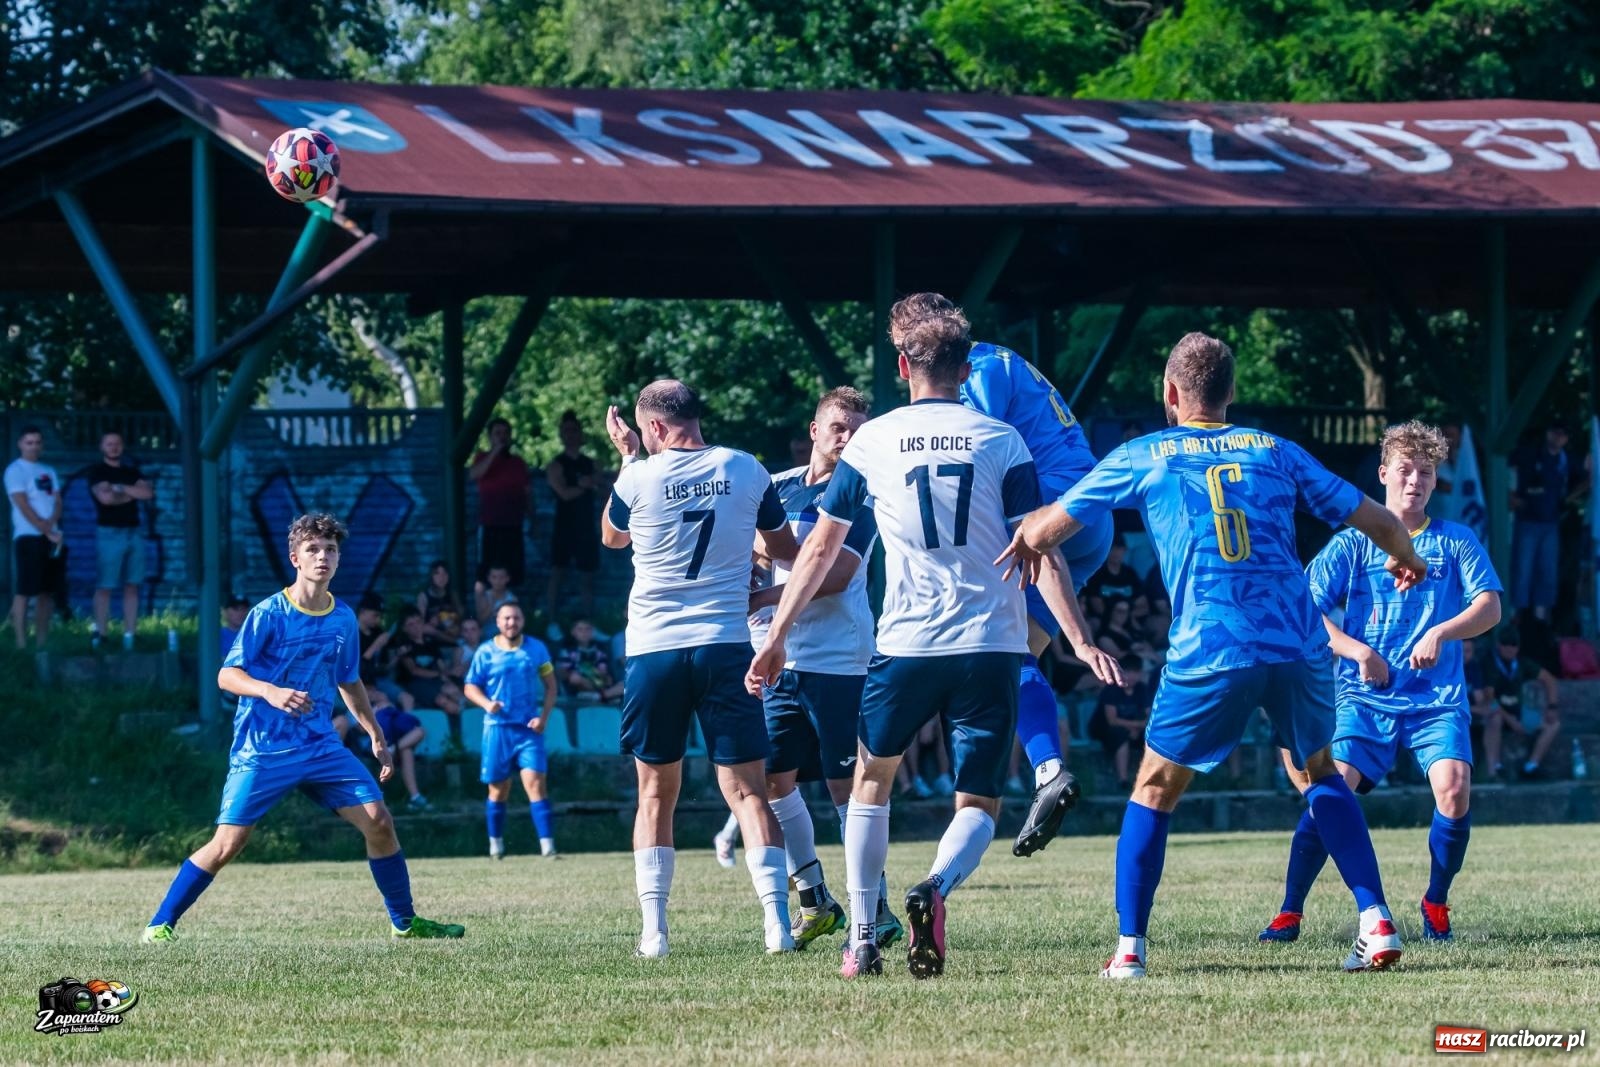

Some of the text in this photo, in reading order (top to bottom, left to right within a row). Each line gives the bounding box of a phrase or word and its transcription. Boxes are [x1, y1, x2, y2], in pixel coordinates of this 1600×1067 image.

[900, 436, 973, 453] LKS OCICE
[1149, 440, 1178, 460] LKS
[665, 480, 731, 500] LKS OCICE
[905, 463, 975, 550] 17
[1206, 462, 1251, 563] 6
[682, 510, 716, 580] 7
